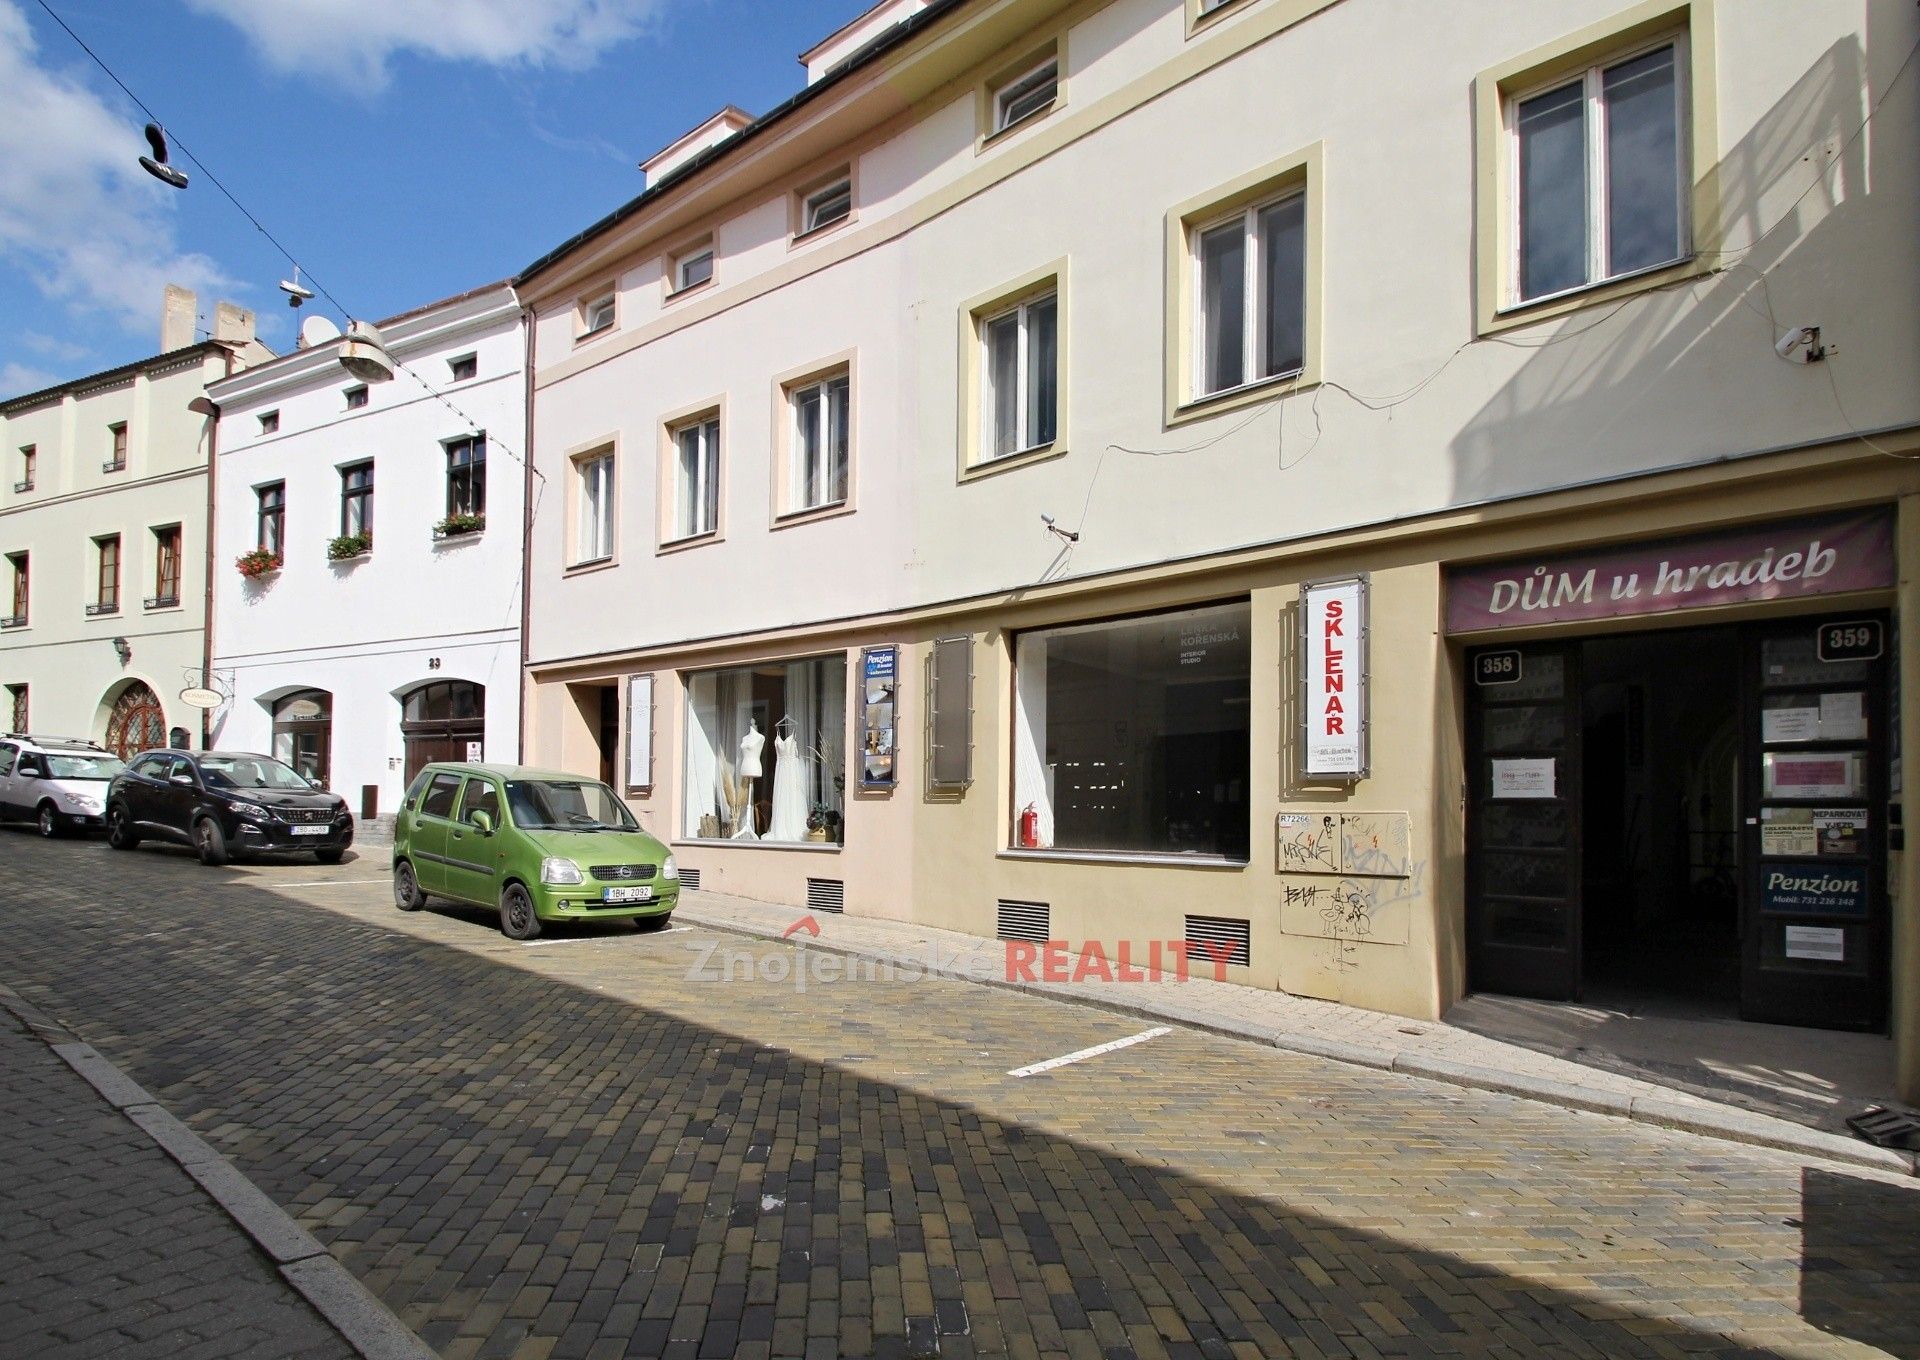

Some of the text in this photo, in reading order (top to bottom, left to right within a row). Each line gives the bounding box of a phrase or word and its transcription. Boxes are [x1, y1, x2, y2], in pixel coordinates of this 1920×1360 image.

[1489, 541, 1837, 614] DŮM u hradeb
[1830, 628, 1869, 652] 359
[867, 654, 893, 664] Penzion
[1180, 649, 1206, 658] INTERIOR
[429, 657, 441, 670] 23
[1180, 657, 1202, 665] STUDIO
[1483, 656, 1512, 674] 358
[1324, 600, 1345, 736] SKLENÁŘ
[1767, 872, 1860, 895] Penzion
[612, 888, 649, 898] 1BH 2092
[1772, 896, 1800, 904] Mobil:
